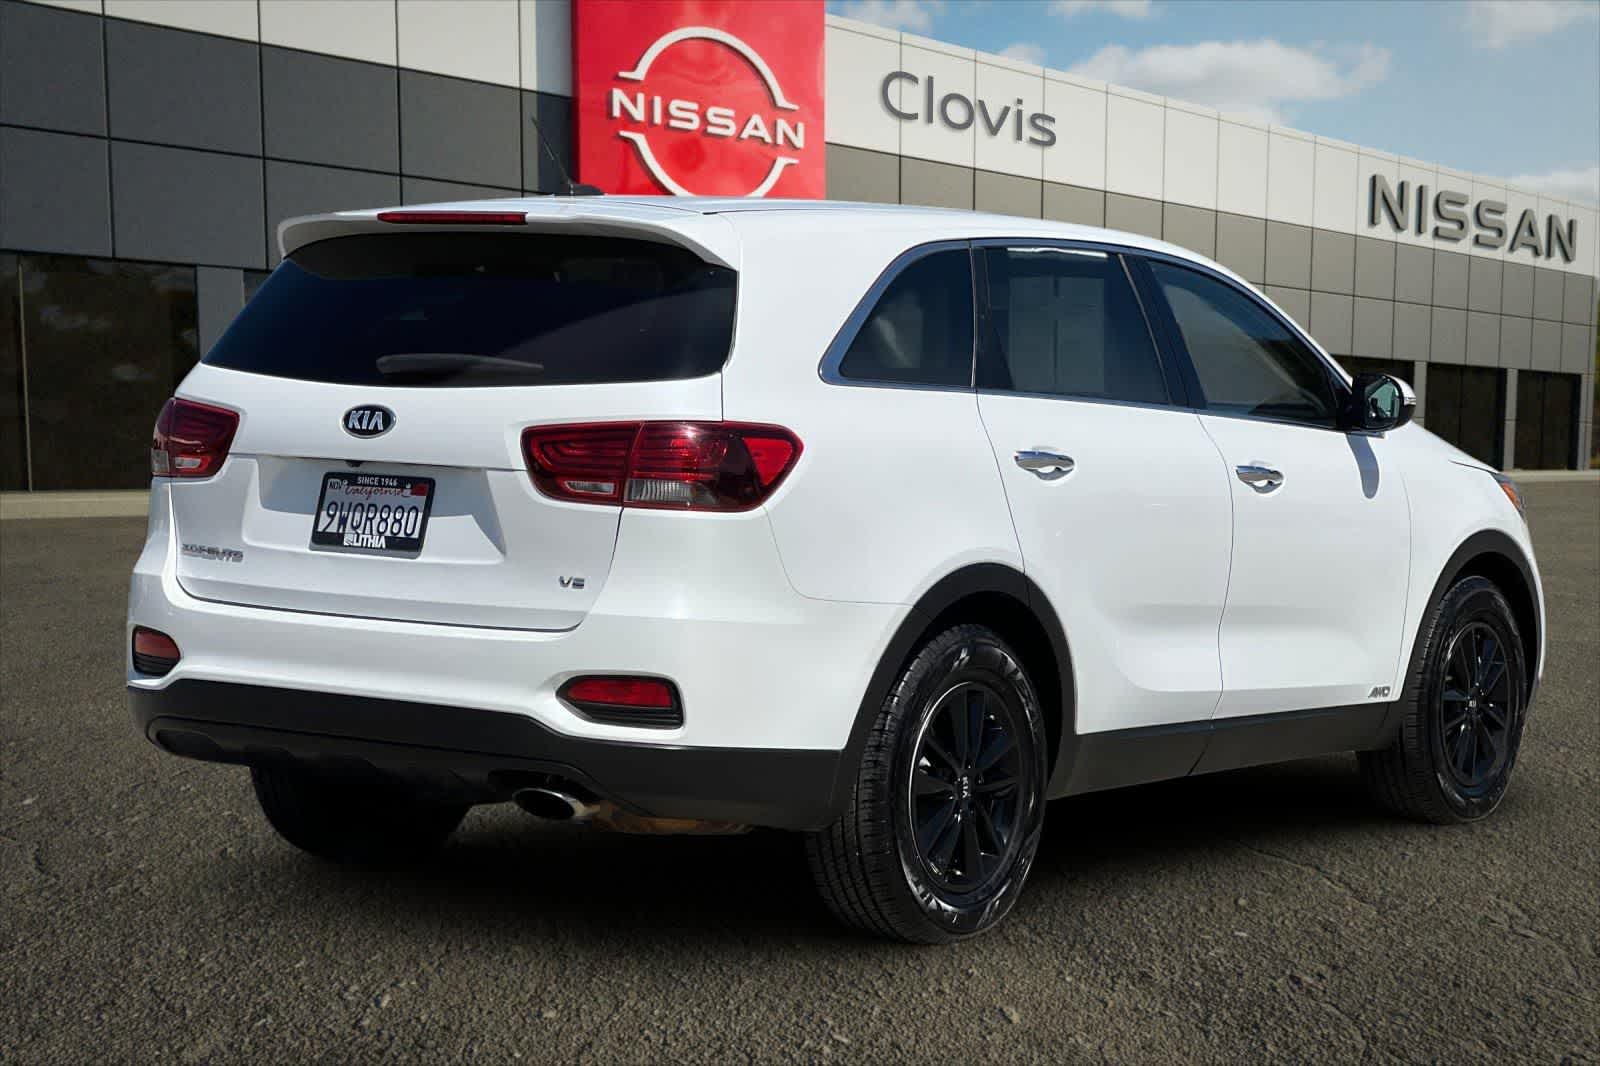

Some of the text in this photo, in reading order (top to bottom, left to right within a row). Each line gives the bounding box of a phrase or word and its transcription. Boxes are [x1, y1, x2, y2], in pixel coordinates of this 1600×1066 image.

[611, 87, 806, 150] NISSAN
[881, 70, 1057, 148] Clovis
[1369, 173, 1577, 263] NISSAN
[348, 410, 383, 430] KIA
[357, 476, 398, 487] SINCE 1946
[324, 501, 419, 537] 9WQR880
[354, 533, 387, 549] LITHIA
